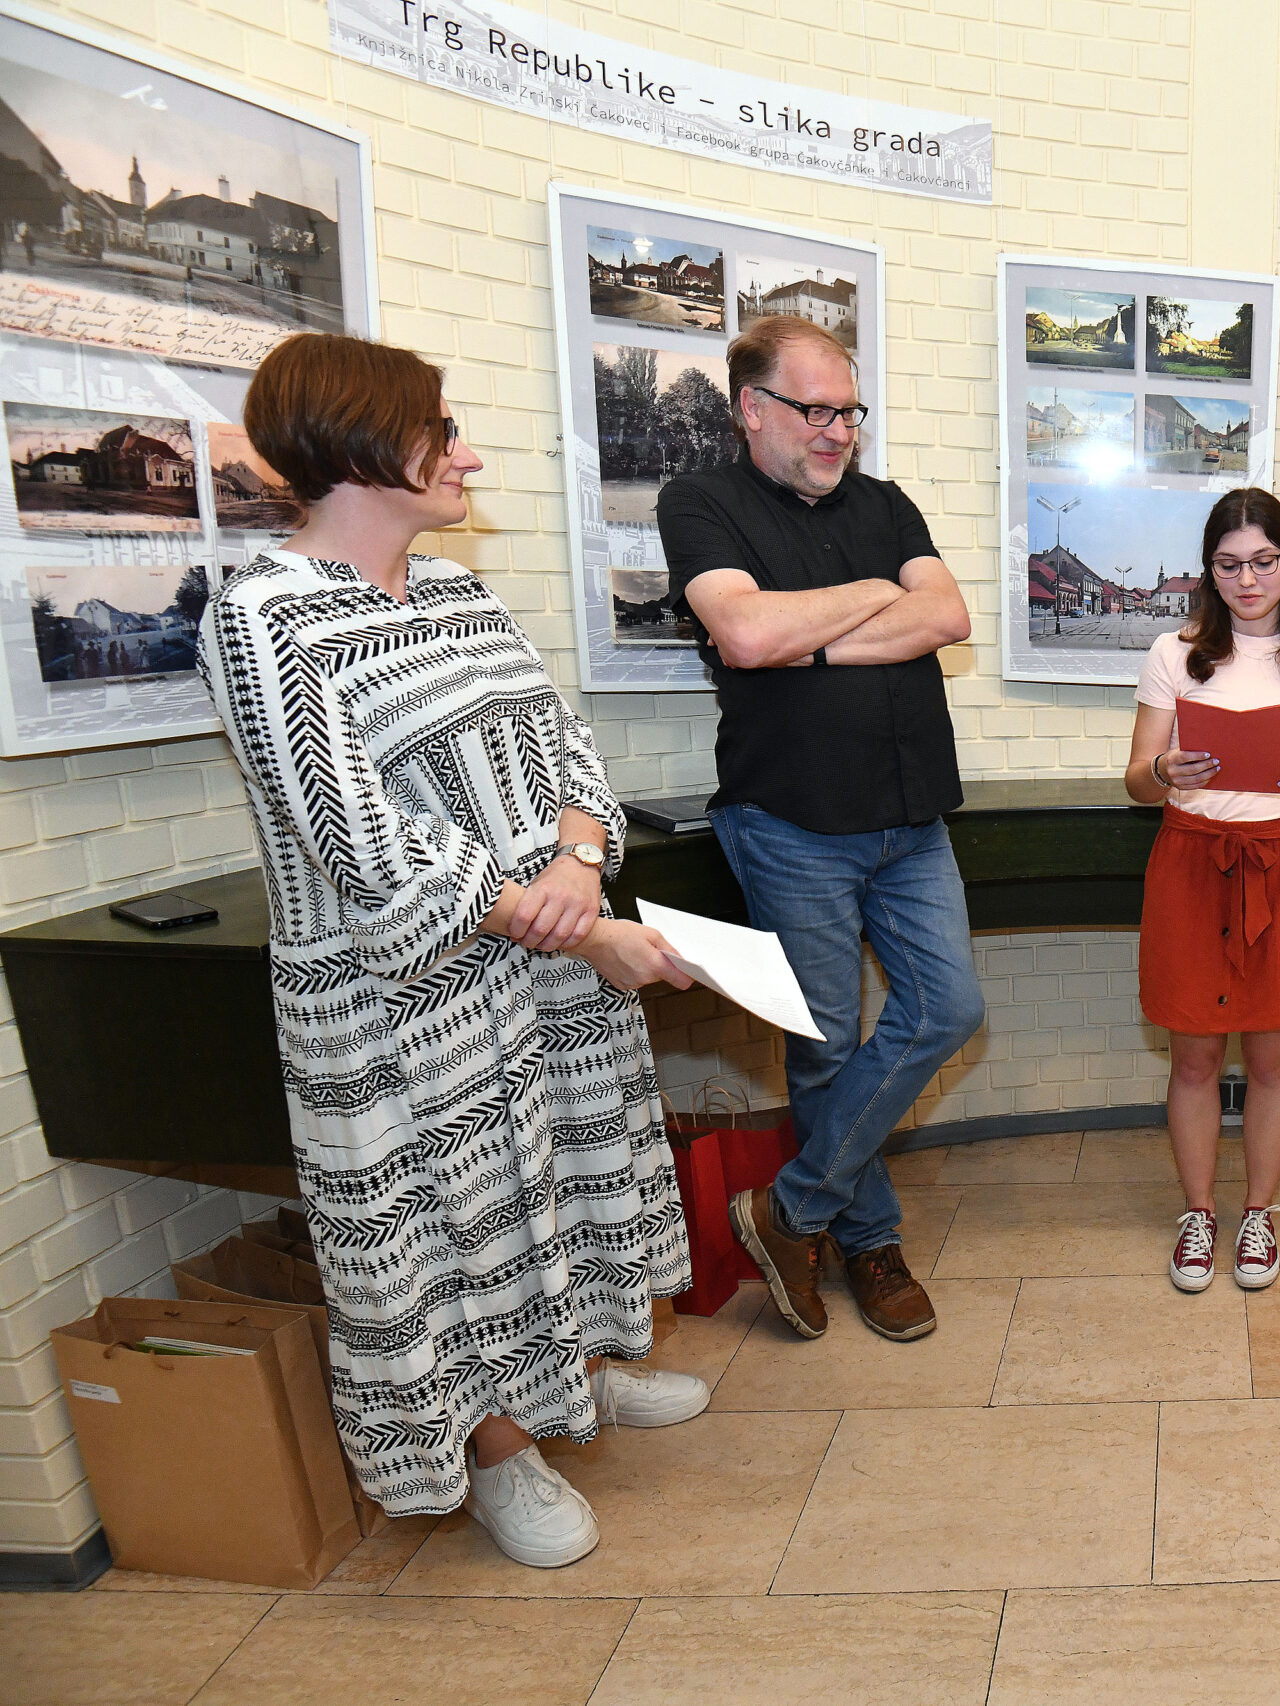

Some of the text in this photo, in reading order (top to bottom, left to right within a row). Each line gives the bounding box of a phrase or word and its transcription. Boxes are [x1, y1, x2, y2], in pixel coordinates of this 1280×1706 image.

[358, 34, 446, 73] Knjižnica
[456, 66, 510, 93] Nikola
[520, 85, 580, 113] Zrinski
[590, 103, 650, 131] Čakovec
[677, 126, 741, 150] Facebook
[750, 145, 790, 162] grupa
[797, 151, 875, 176] Čakovčanke
[400, 0, 463, 50] Trg
[489, 28, 675, 104] Republike
[739, 100, 831, 138] slika
[853, 127, 941, 158] grada
